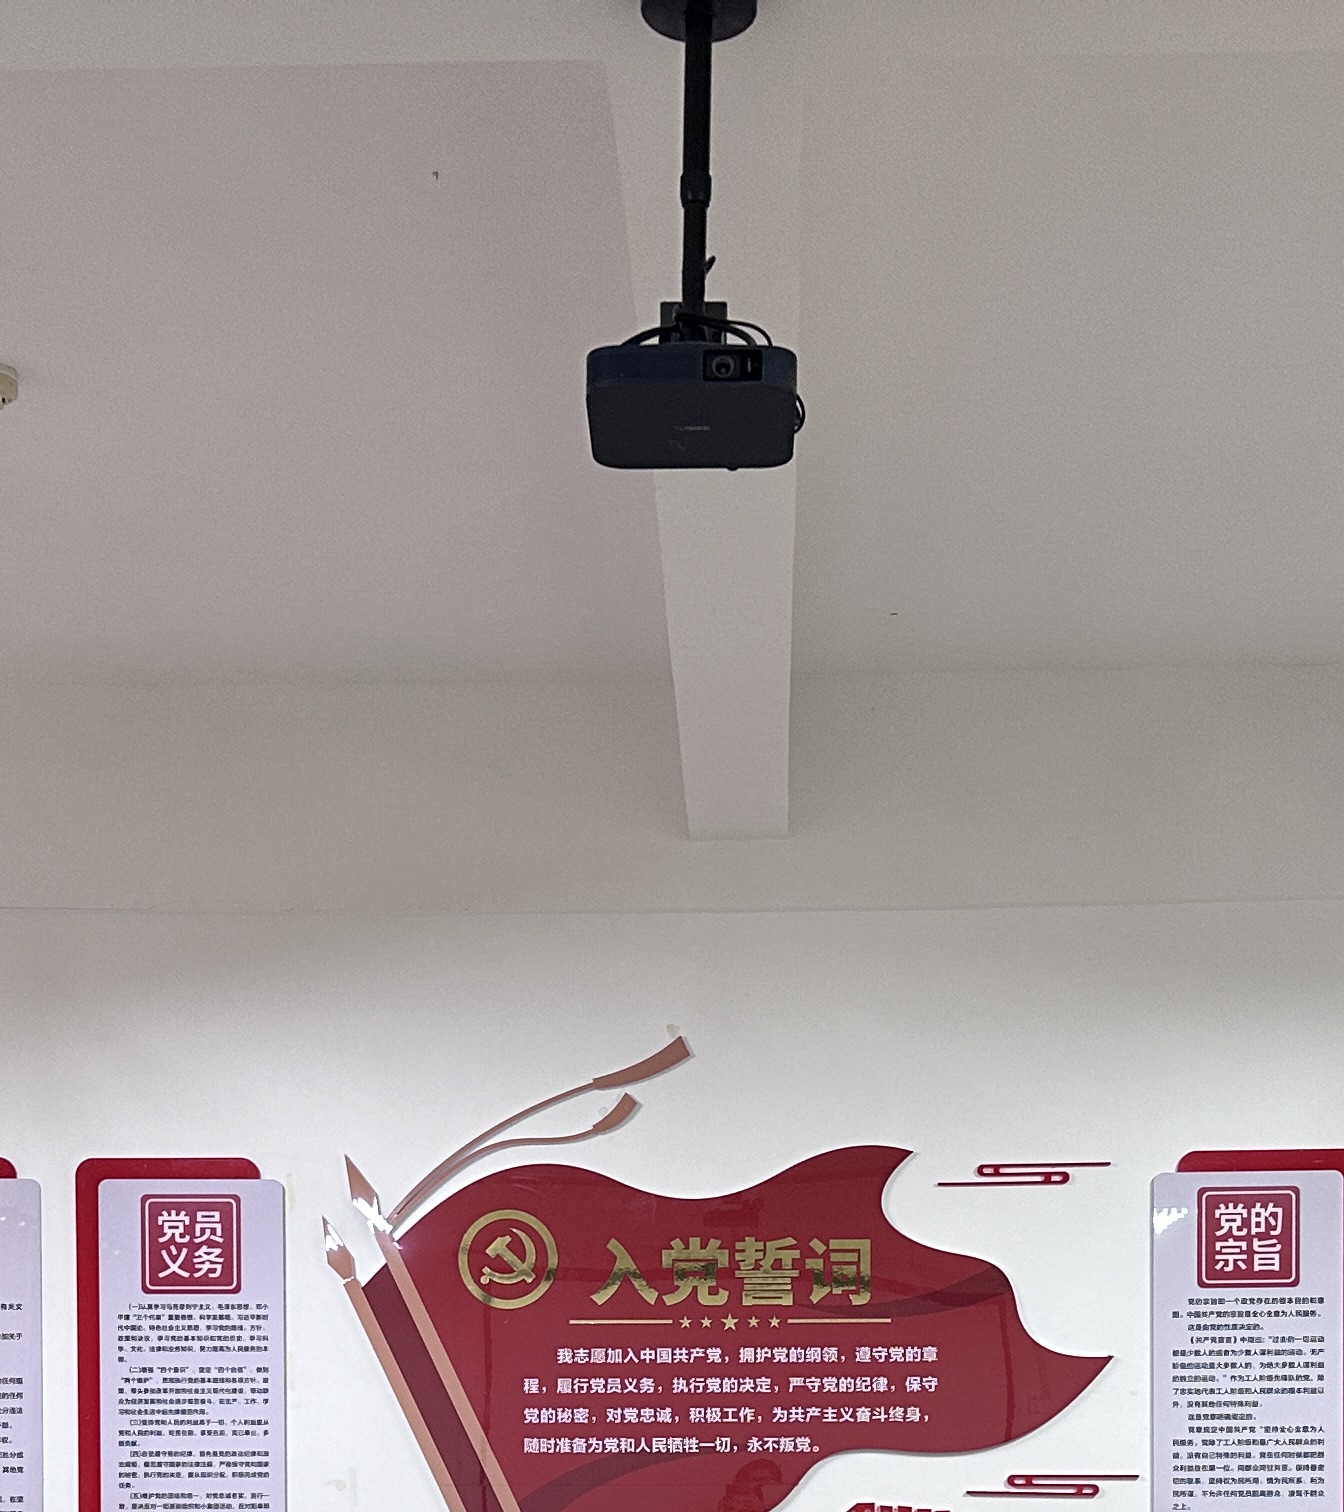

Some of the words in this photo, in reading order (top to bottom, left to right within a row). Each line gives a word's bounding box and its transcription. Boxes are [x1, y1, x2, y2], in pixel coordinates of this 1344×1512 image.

[156, 1209, 224, 1243] 党员
[1213, 1202, 1284, 1235] 党的
[156, 1245, 225, 1278] 义务
[1212, 1238, 1284, 1272] 宗旨
[589, 1237, 873, 1308] 入党誓词
[556, 1346, 939, 1364] 我志愿加入中国共产党，拥护党的纲领，遵守党的章
[522, 1376, 939, 1394] 程，履行党员义务，执行党的决定，严守党的纪律，保守
[522, 1406, 931, 1424] 党的秘密，对党忠诚，积极工作，为共产主义奋斗终身，
[522, 1436, 821, 1454] 随时准备为党和人民牺牲一切，永不叛党。
